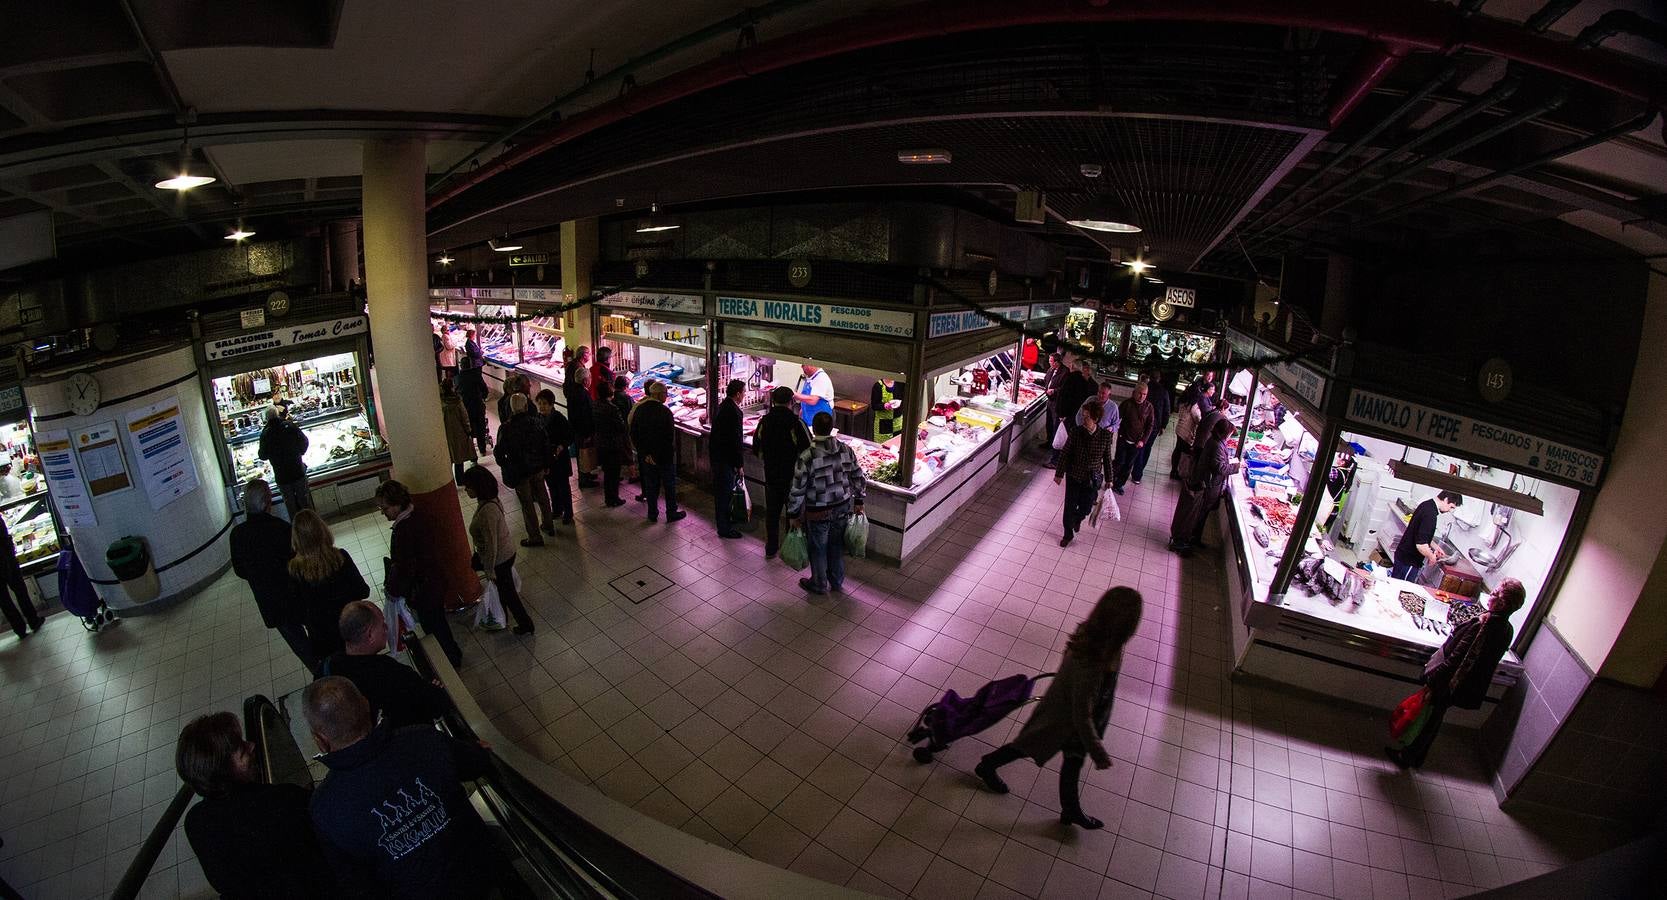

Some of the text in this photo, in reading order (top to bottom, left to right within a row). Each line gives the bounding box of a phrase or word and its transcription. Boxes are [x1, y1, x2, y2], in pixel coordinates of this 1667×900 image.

[792, 266, 808, 278] 233
[270, 300, 287, 311] 222
[1168, 289, 1195, 306] ASEOS
[718, 297, 758, 317] TERESA
[764, 301, 823, 324] MORALES
[830, 306, 872, 317] PESCADOS
[291, 319, 363, 344] Tomas Cano
[830, 320, 870, 331] MARISCOS
[931, 313, 961, 336] TERESA
[210, 339, 282, 359] Y CONSERVAS
[215, 331, 274, 349] SALAZONES
[1486, 372, 1505, 389] 143
[1353, 393, 1599, 470] MANOLO Y PEPE PESCADOS Y MARISCOS
[1545, 460, 1562, 474] 521
[1566, 465, 1578, 478] 75
